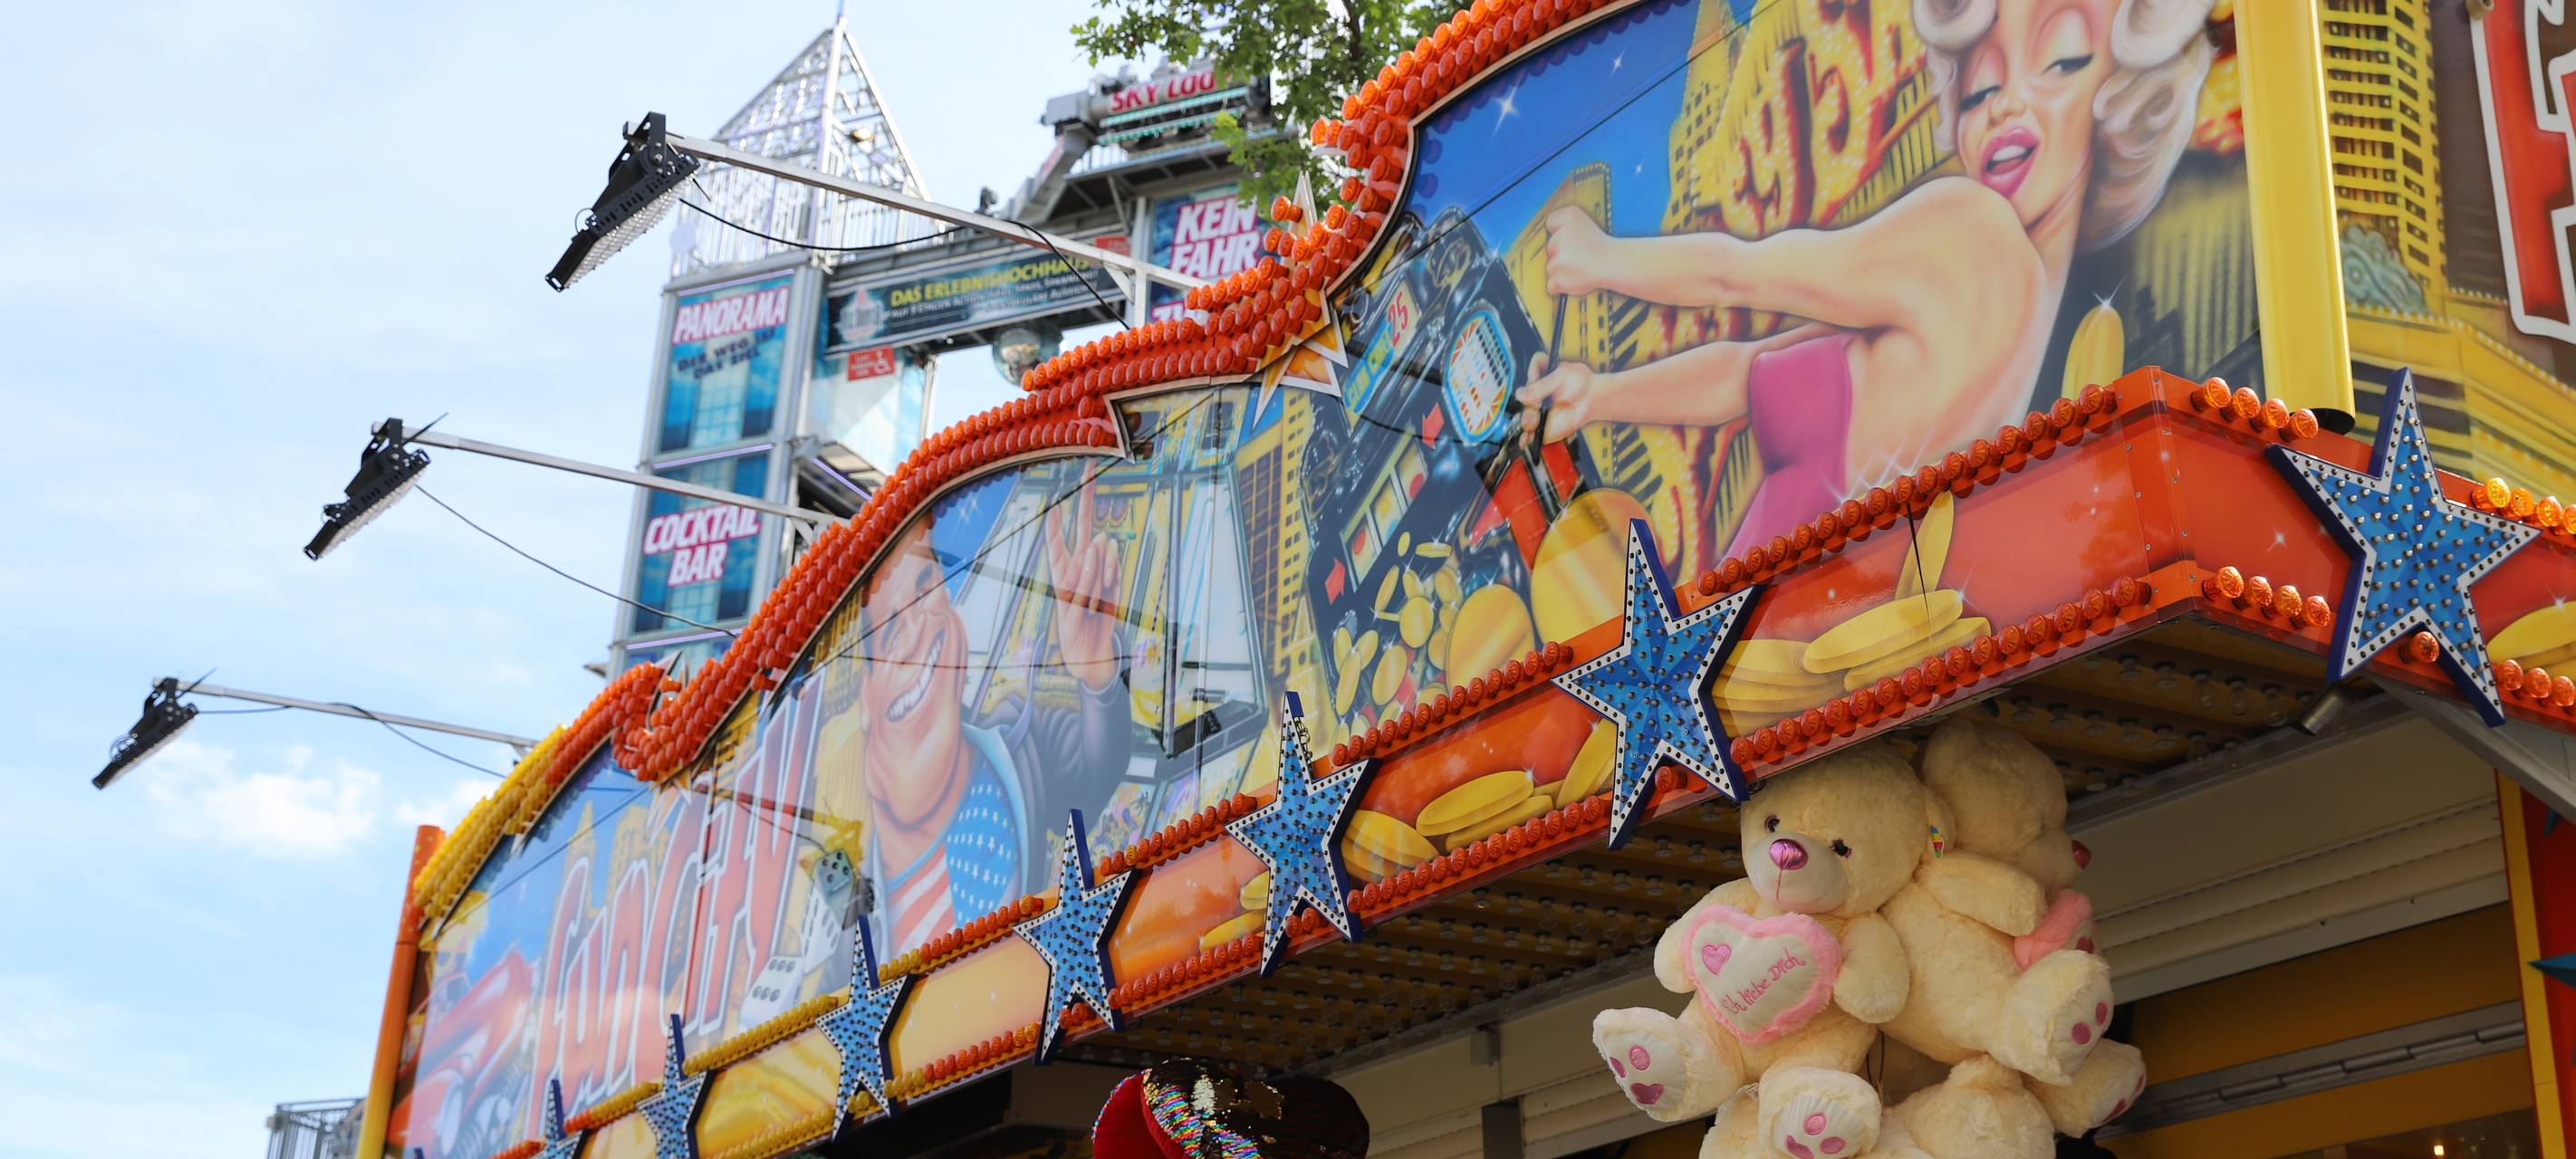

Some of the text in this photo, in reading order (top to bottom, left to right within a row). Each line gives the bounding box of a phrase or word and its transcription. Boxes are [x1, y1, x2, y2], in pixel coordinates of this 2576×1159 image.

[1110, 82, 1160, 112] SKY
[1174, 195, 1259, 244] KEIN
[1170, 231, 1262, 278] FAHR
[672, 286, 790, 345] PANORAMA
[890, 286, 922, 307] DAS
[1388, 291, 1409, 346] 25
[643, 503, 762, 554] COCKTAIL
[668, 541, 727, 587] BAR
